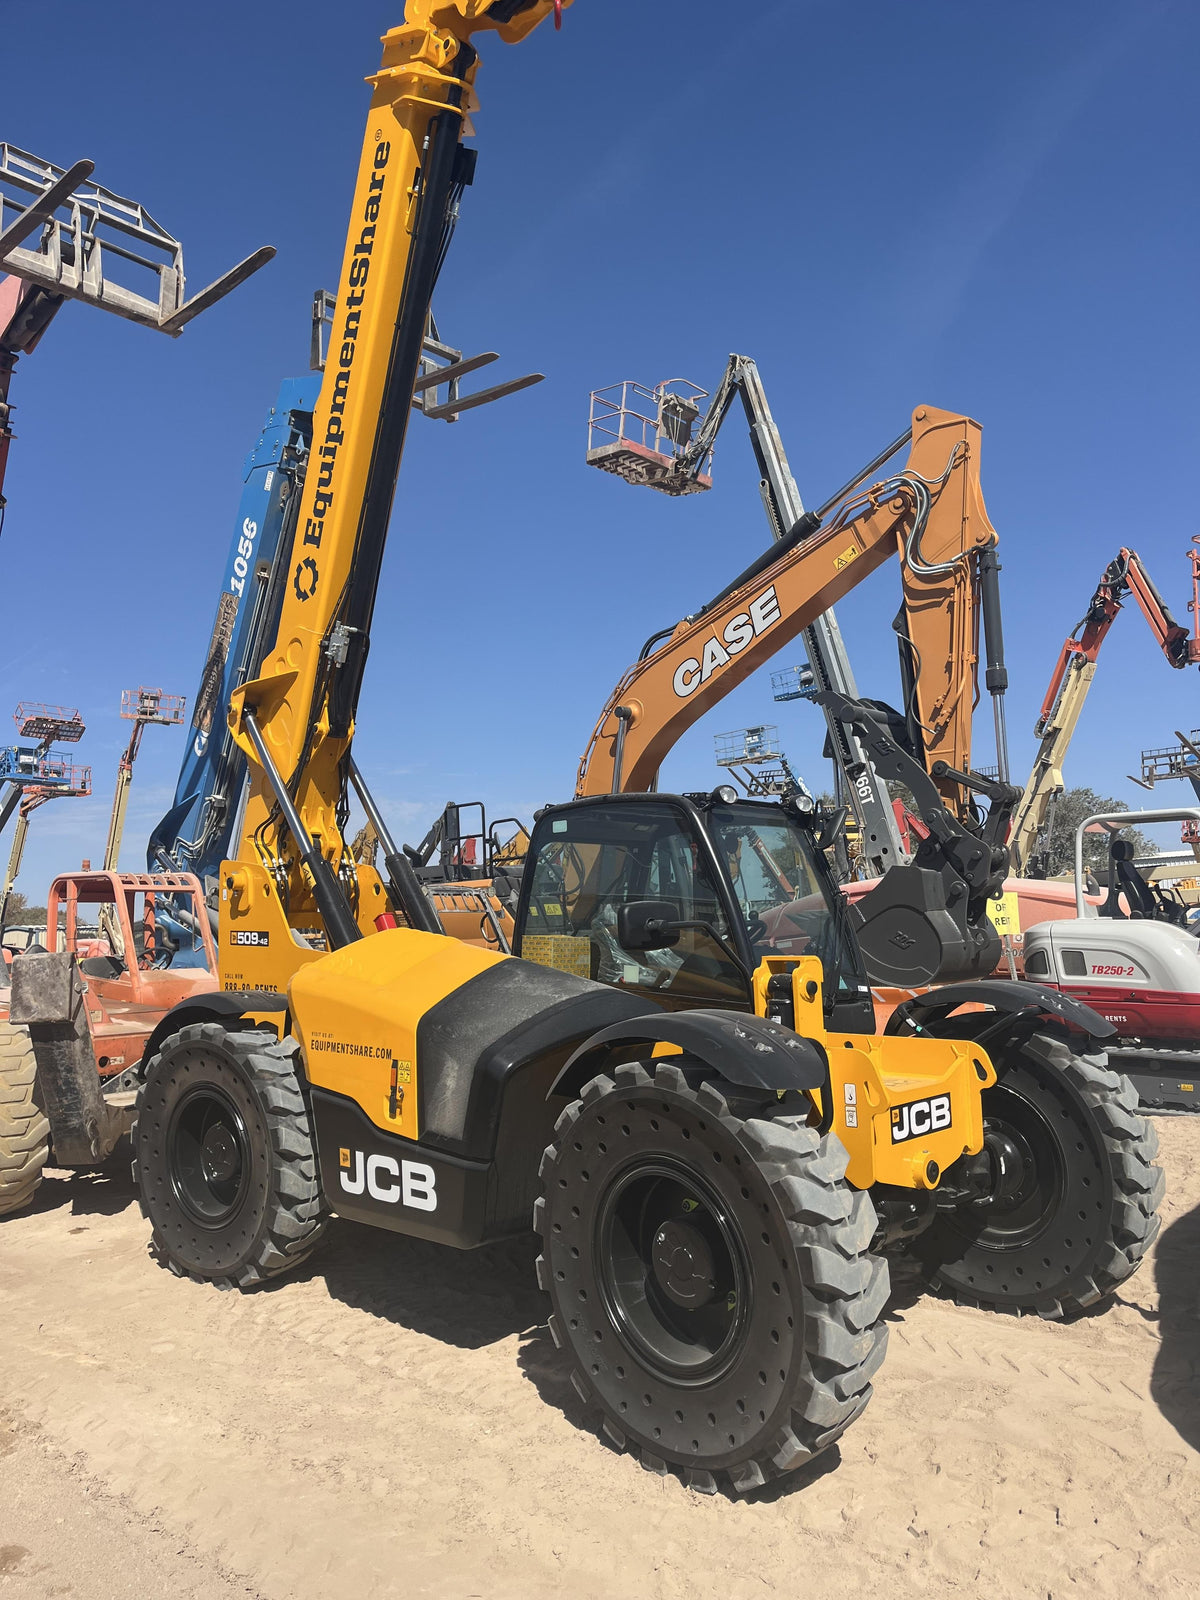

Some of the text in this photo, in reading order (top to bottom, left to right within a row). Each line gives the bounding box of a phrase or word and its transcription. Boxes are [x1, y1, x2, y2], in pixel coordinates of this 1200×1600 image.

[229, 517, 258, 598] 1056
[672, 584, 782, 698] CASE
[1091, 965, 1135, 976] TB250-2
[1105, 1015, 1127, 1023] RENTS
[311, 1039, 392, 1060] EQUIPMENTSHARE.COM
[892, 1097, 951, 1140] JCB
[340, 1150, 438, 1212] JCB
